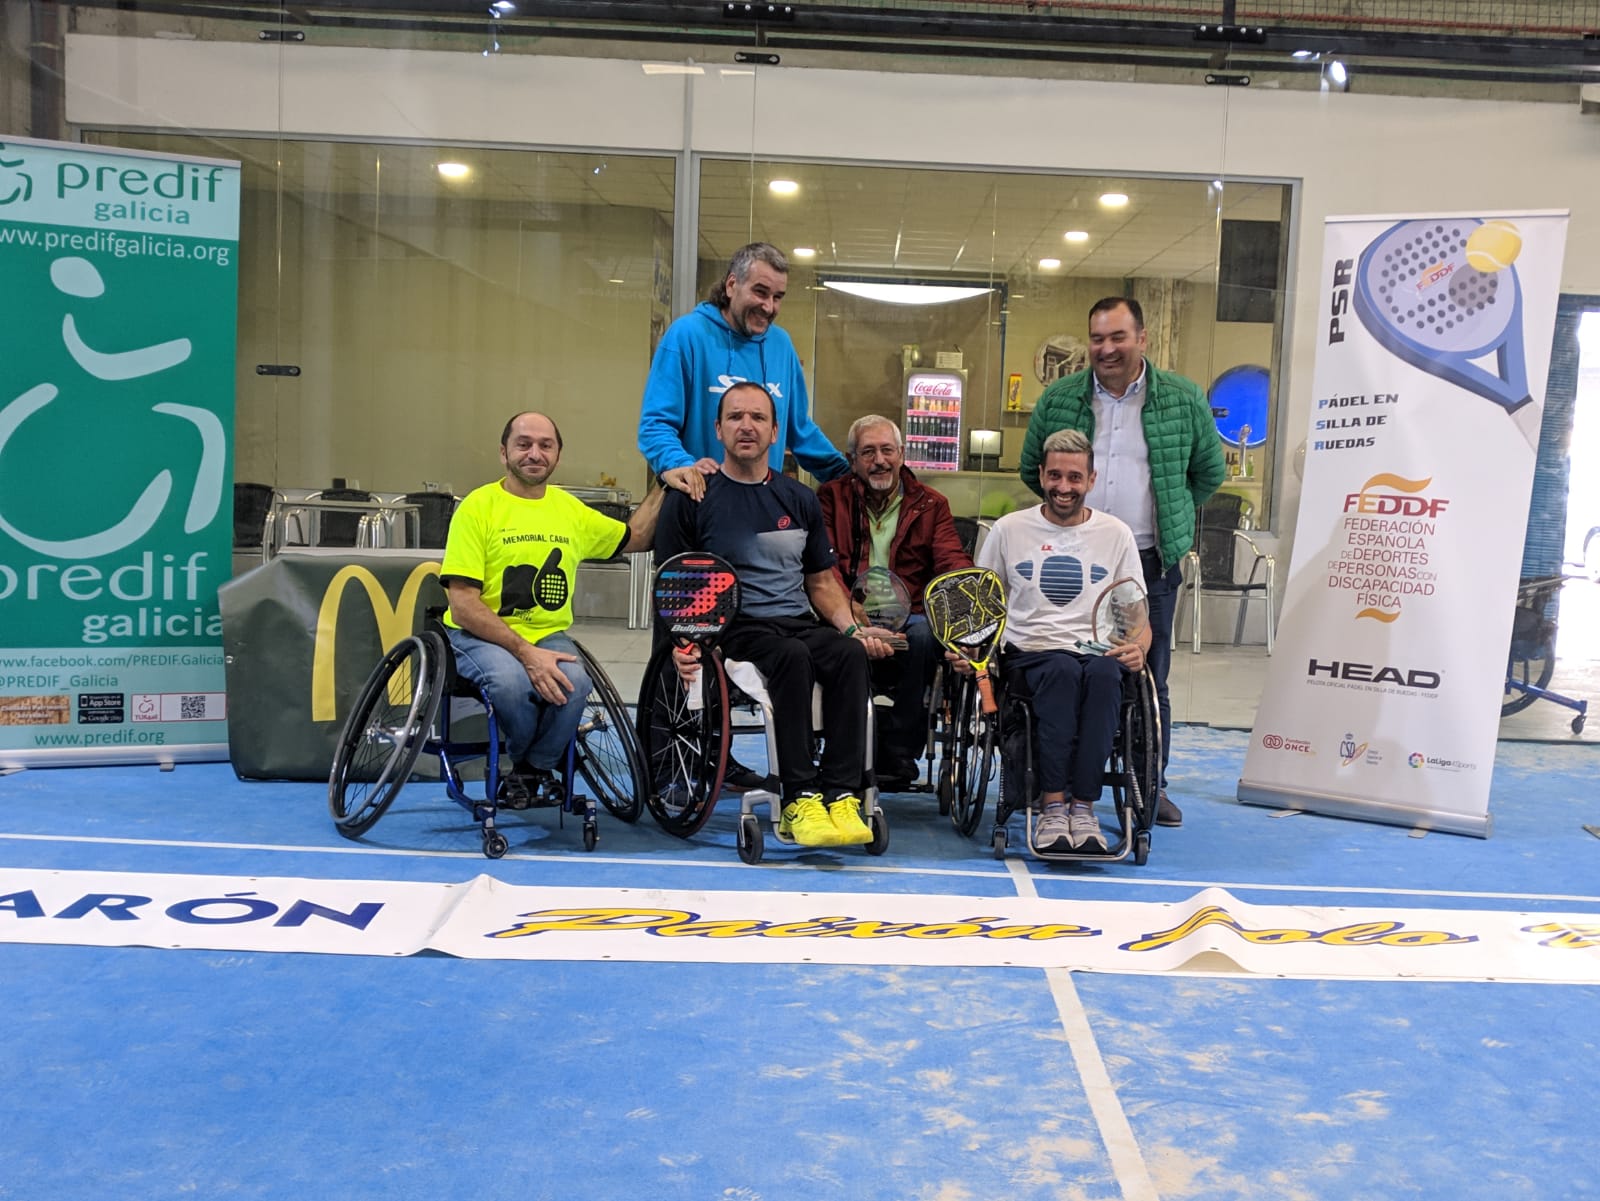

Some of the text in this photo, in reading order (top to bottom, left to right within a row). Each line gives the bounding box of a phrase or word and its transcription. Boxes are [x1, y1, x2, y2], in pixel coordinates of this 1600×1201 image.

[57, 162, 224, 203] predif
[94, 200, 191, 225] galicia
[1328, 258, 1355, 346] PSR
[1318, 393, 1399, 409] PÁDEL EN
[1315, 415, 1388, 430] SILLA DE
[1314, 437, 1376, 451] RUEDAS
[1343, 493, 1450, 518] FEDDF
[1344, 518, 1436, 536] FEDERACIÓN
[502, 534, 547, 545] MEMORIAL
[1348, 532, 1425, 550] ESPAÑOLA
[1328, 575, 1435, 596] DISCAPACIDAD
[1356, 591, 1402, 609] FÍSICA
[82, 607, 223, 644] galicia
[670, 624, 722, 634] Bullpadel
[1308, 659, 1441, 689] HEAD
[35, 728, 165, 747] www.predif.org
[1284, 743, 1310, 753] ONCE
